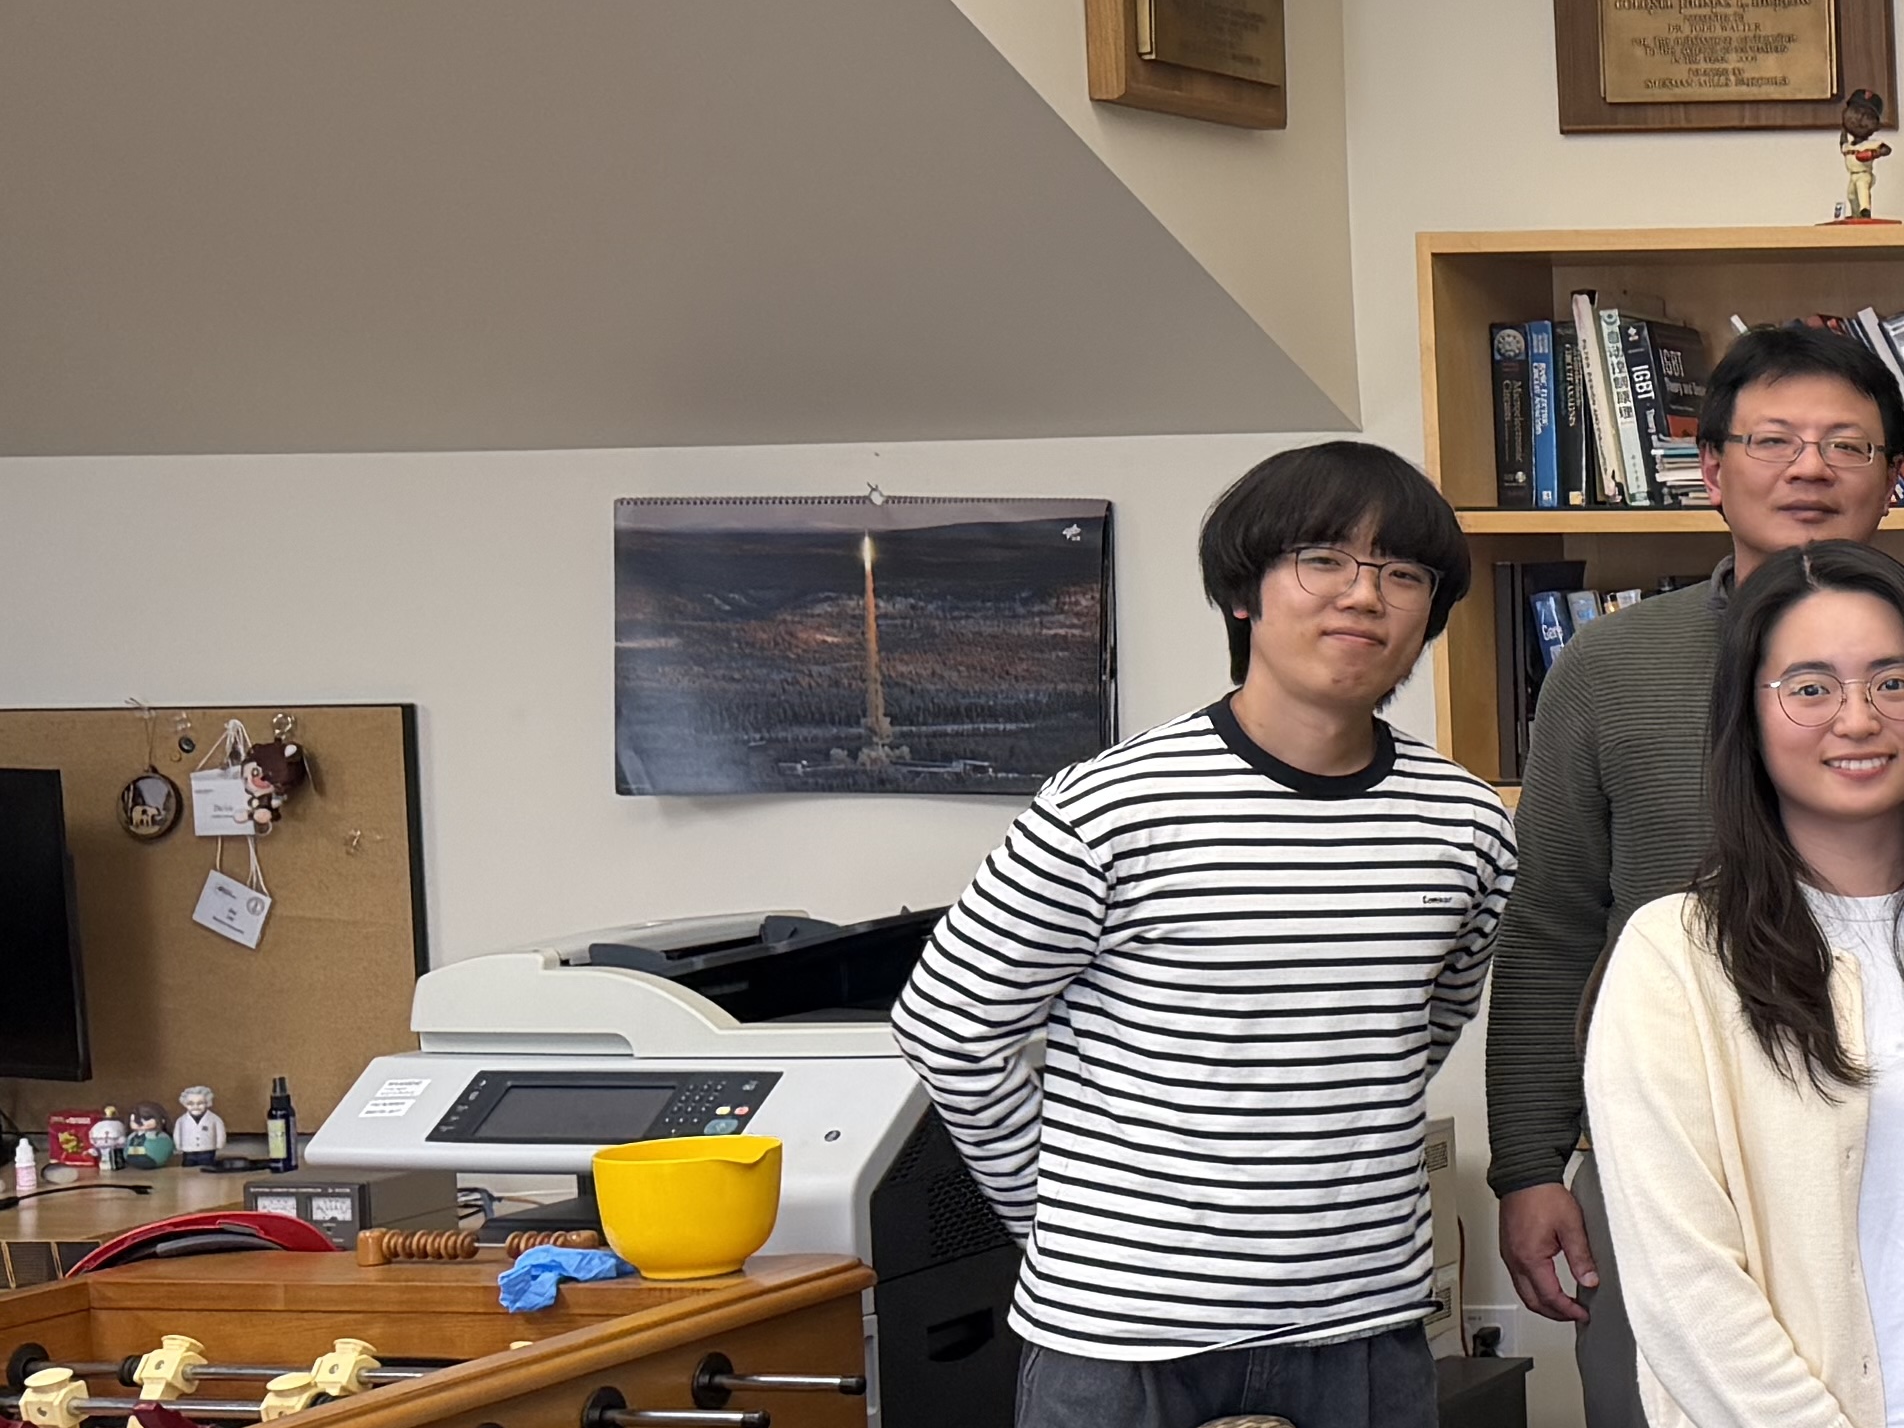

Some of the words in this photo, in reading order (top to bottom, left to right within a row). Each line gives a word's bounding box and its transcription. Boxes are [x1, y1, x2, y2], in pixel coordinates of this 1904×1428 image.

[1689, 24, 1716, 34] TODD
[1719, 23, 1762, 33] WALTER
[1581, 338, 1590, 369] FILTER
[1659, 348, 1684, 378] IGBT
[1631, 365, 1655, 401] IGBT
